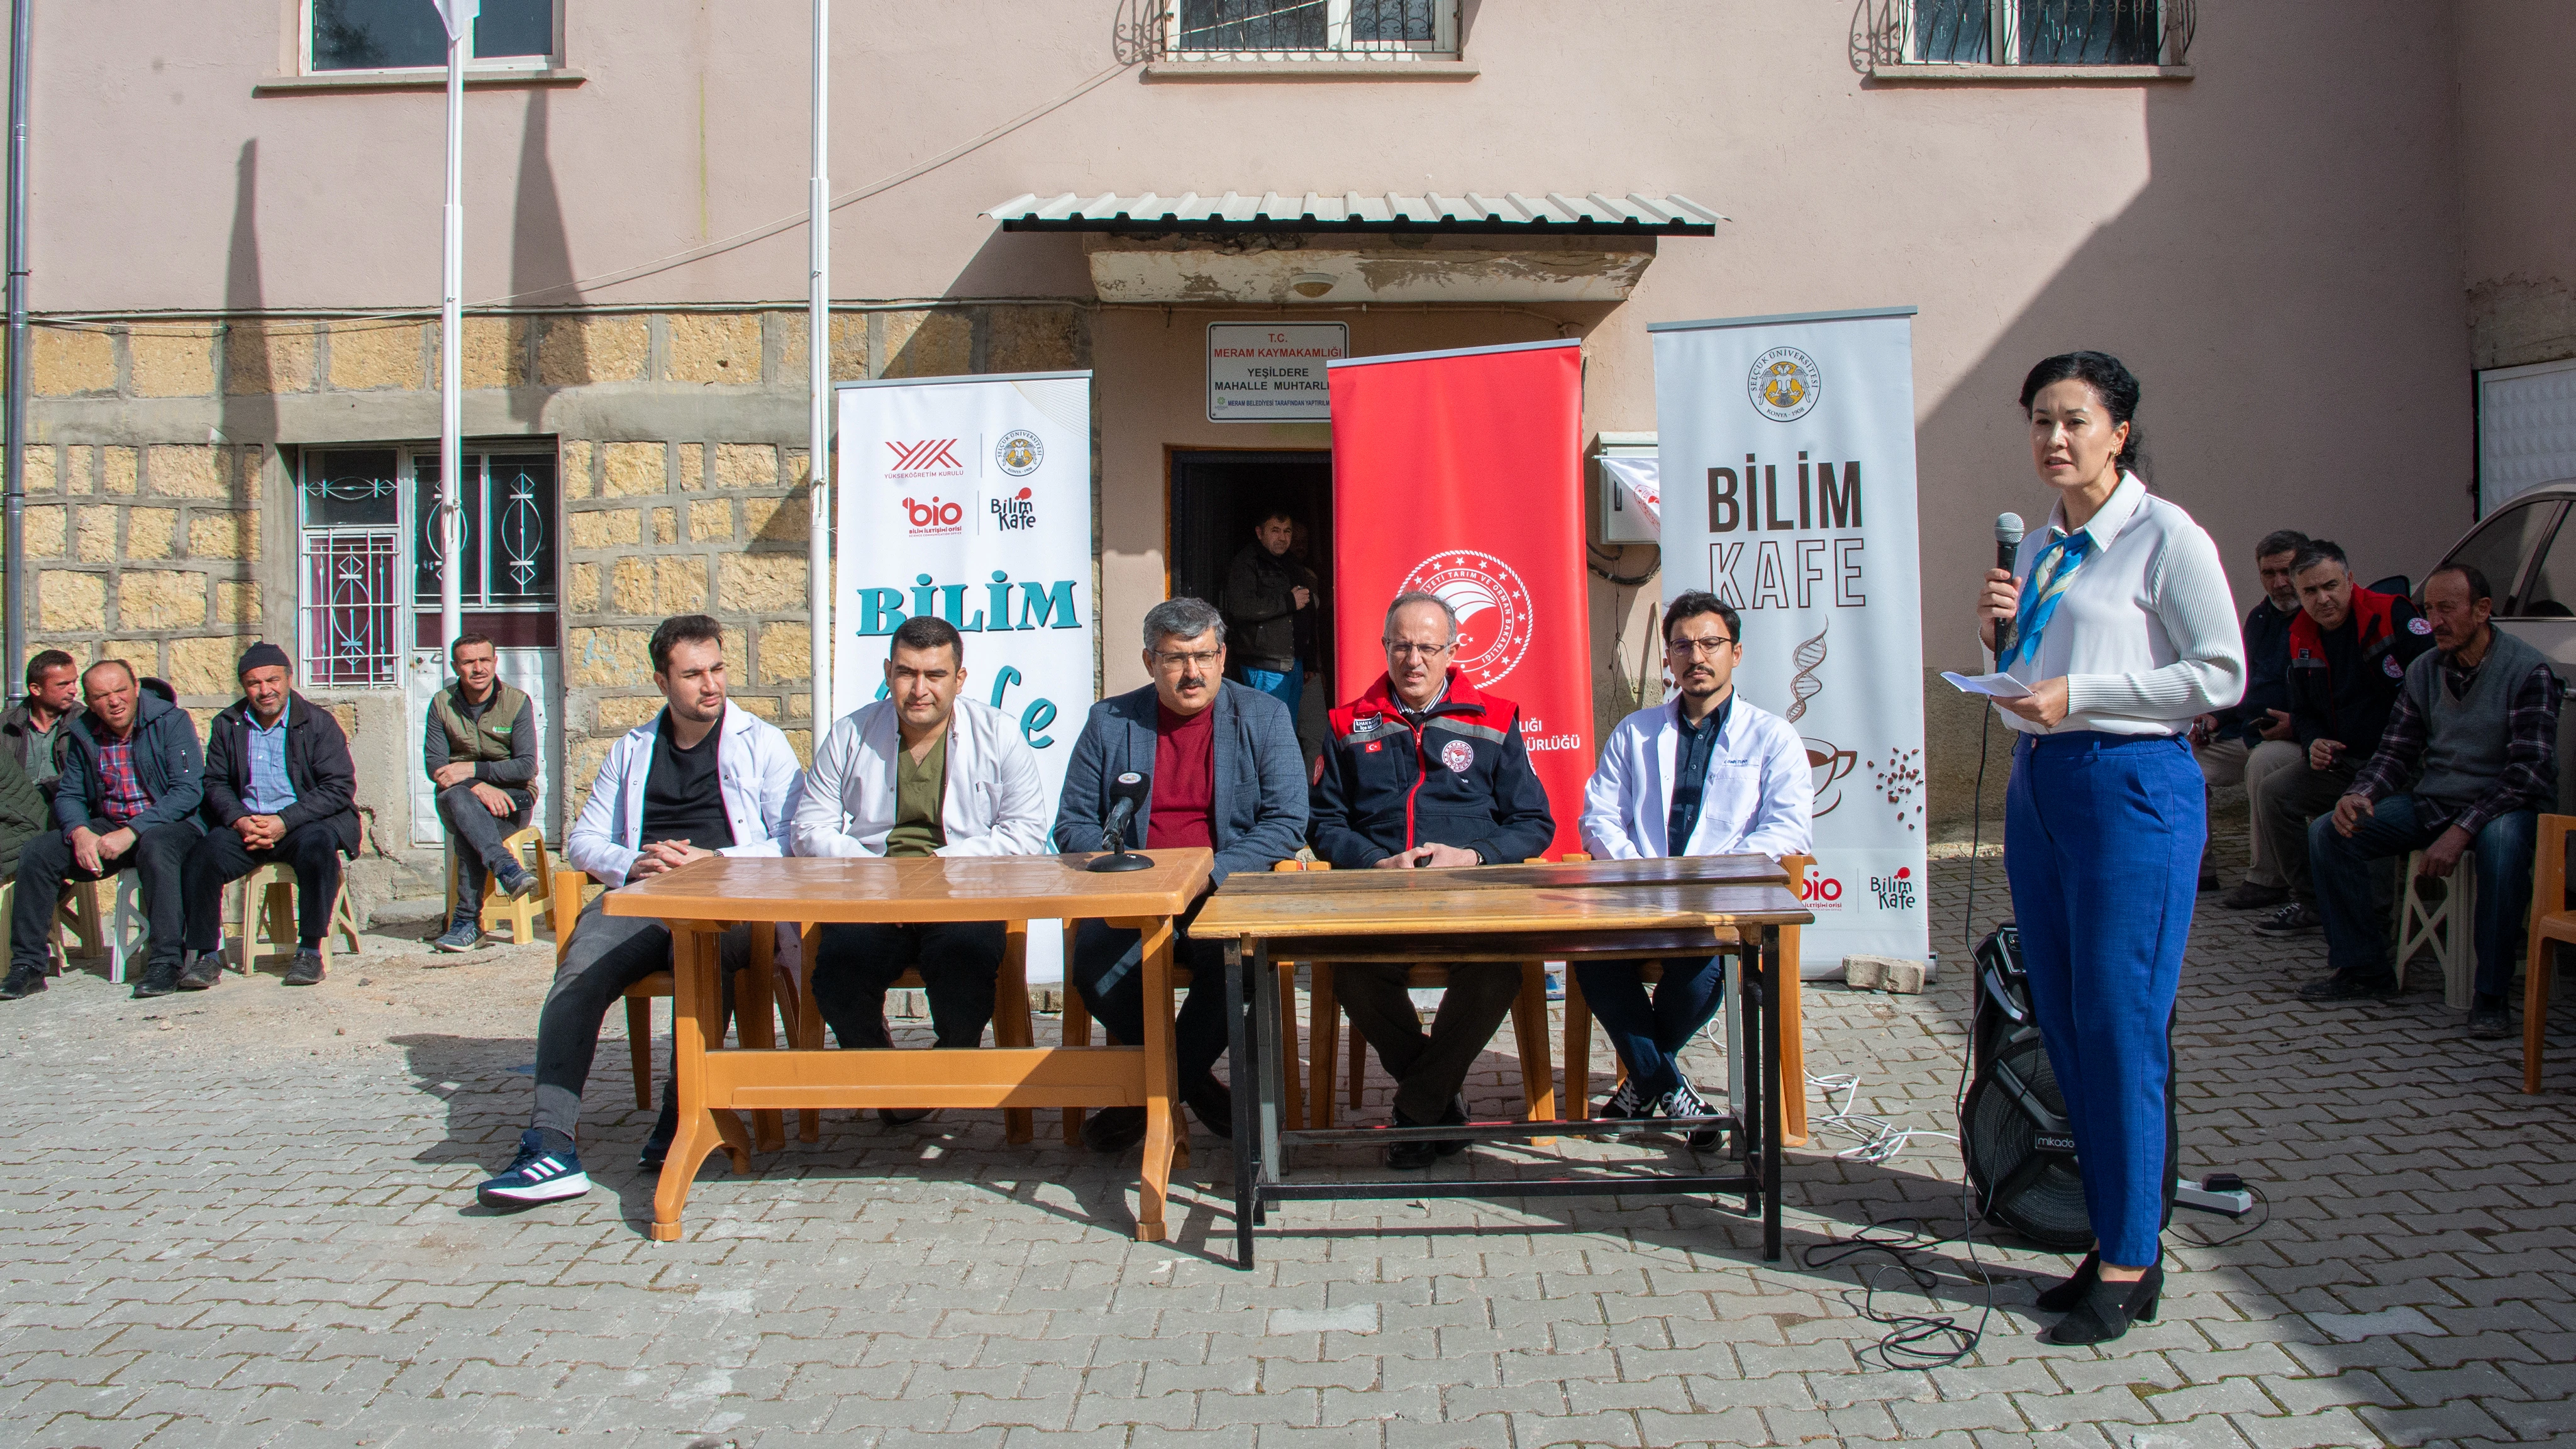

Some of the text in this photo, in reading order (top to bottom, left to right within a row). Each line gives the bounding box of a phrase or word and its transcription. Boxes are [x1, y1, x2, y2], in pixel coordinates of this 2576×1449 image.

[1268, 333, 1287, 343] T.C.
[1214, 347, 1342, 357] MERAM KAYMAKAMLIĞI
[1247, 367, 1309, 379] YEŞİLDERE
[1751, 349, 1819, 391] SELÇUK ÜNİVERSİTESİ
[1215, 382, 1330, 391] MAHALLE MUHTARLI
[1767, 407, 1804, 418] KONYA 1908
[997, 436, 1010, 458] SELÇUK
[884, 471, 936, 479] YÜKSEKÖĞRETİM
[1707, 450, 1862, 533] BİLİM
[902, 496, 963, 527] bio
[991, 496, 1033, 515] Bilim
[999, 509, 1036, 531] Kafe
[1422, 574, 1445, 593] İYETİ
[1480, 575, 1492, 585] VE
[1709, 538, 1866, 610] KAFE
[856, 570, 1082, 637] BİLİM
[1493, 585, 1511, 614] ORMAN
[1482, 619, 1512, 663] BAKANLIĞI
[1519, 717, 1542, 733] LIĞI
[1524, 735, 1580, 752] ÜRLÜĞÜ
[1870, 875, 1912, 893] Bilim
[1878, 889, 1916, 910] Kafe
[2038, 1137, 2075, 1148] mikado
